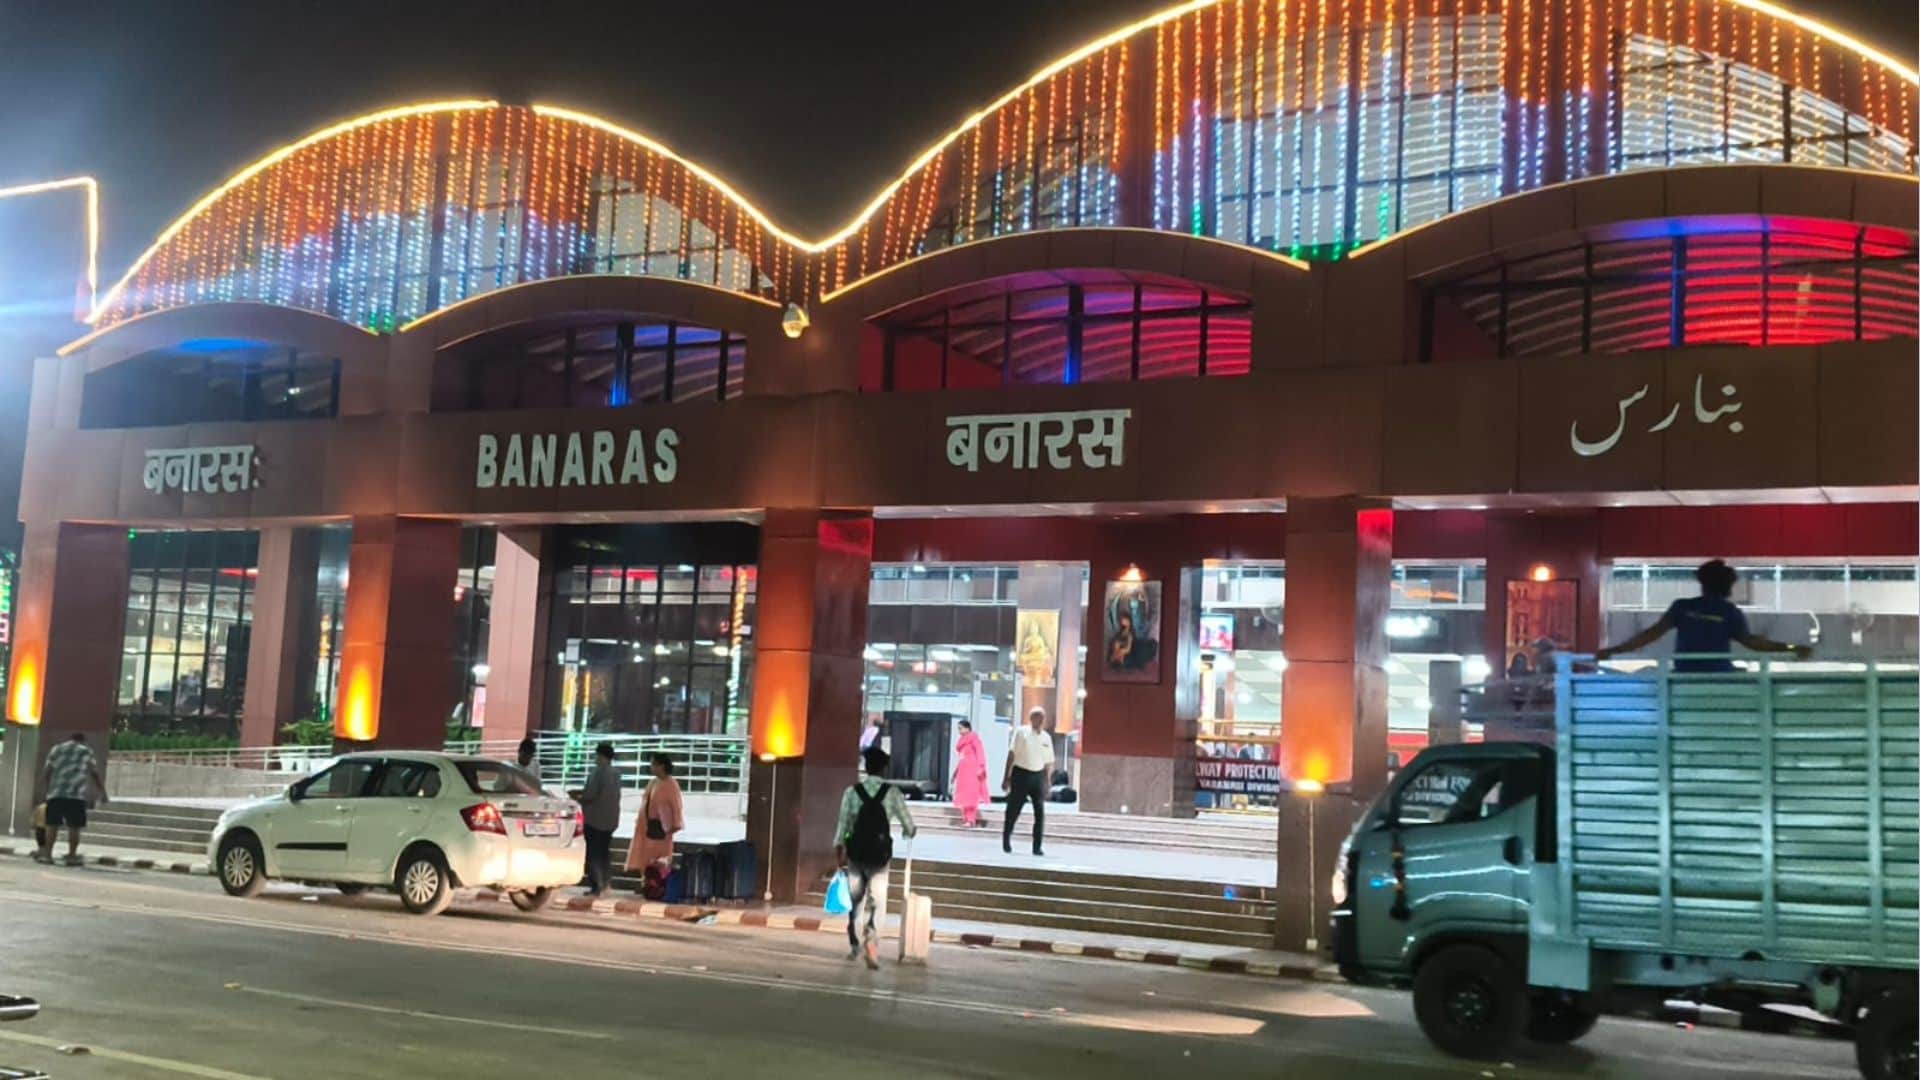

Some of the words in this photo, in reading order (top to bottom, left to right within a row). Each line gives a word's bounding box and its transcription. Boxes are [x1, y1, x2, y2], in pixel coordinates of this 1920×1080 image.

[946, 408, 1132, 471] बनारस
[1571, 374, 1744, 456] بنارس
[476, 428, 679, 487] BANARAS
